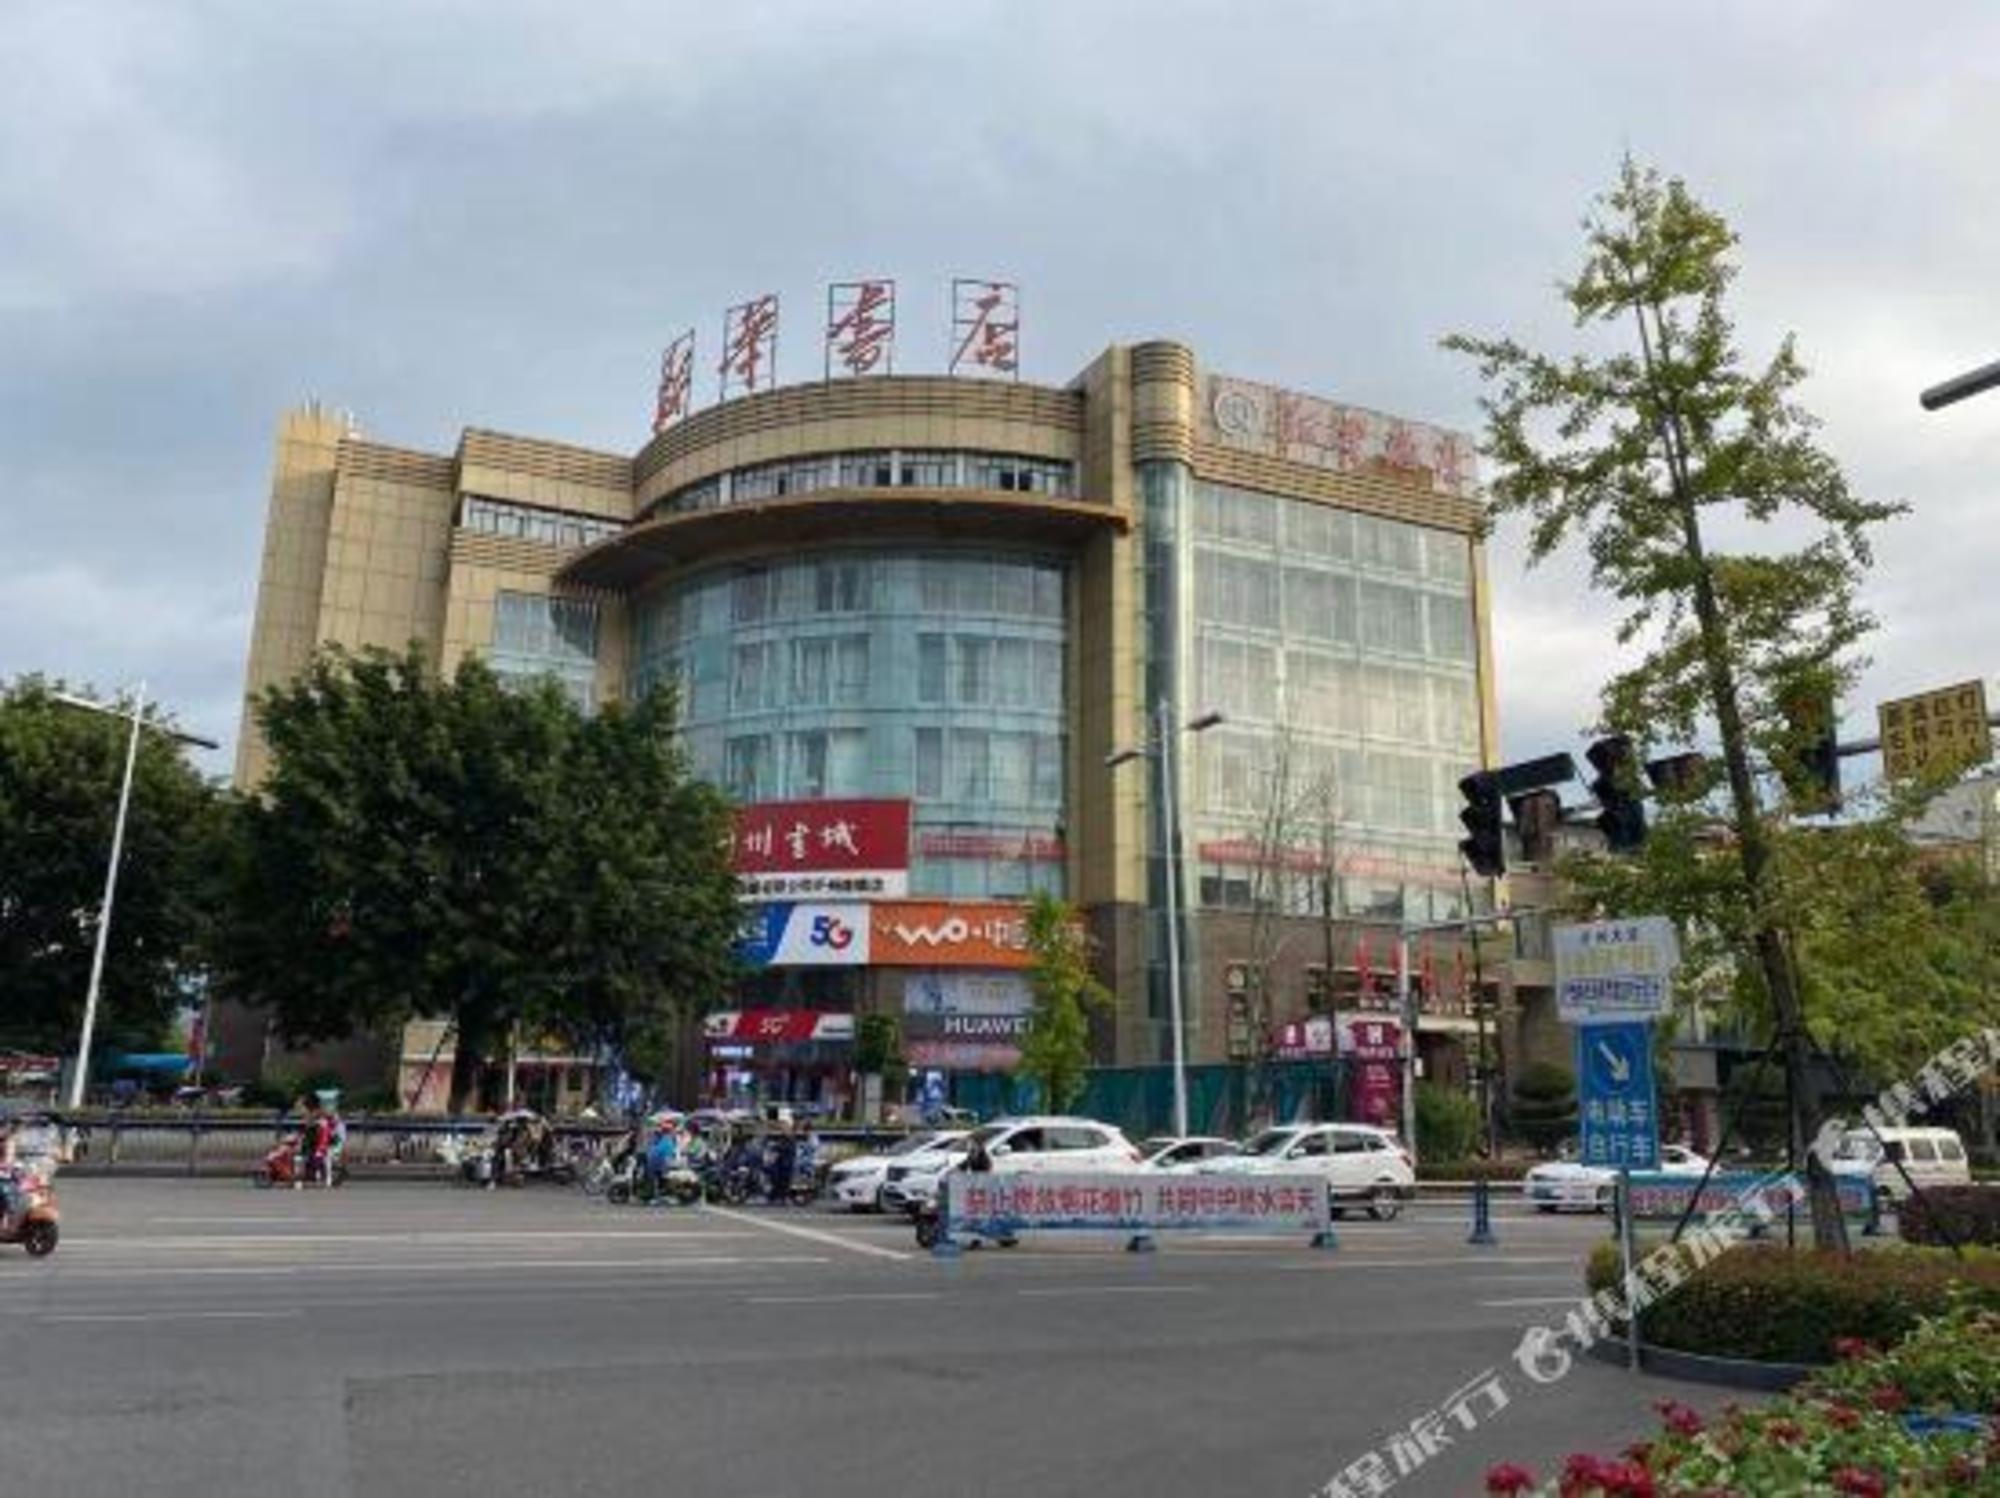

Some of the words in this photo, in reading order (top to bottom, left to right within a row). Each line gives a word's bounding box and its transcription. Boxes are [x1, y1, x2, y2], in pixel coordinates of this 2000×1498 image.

[810, 916, 853, 949] 5G
[1588, 1133, 1652, 1165] 自行车
